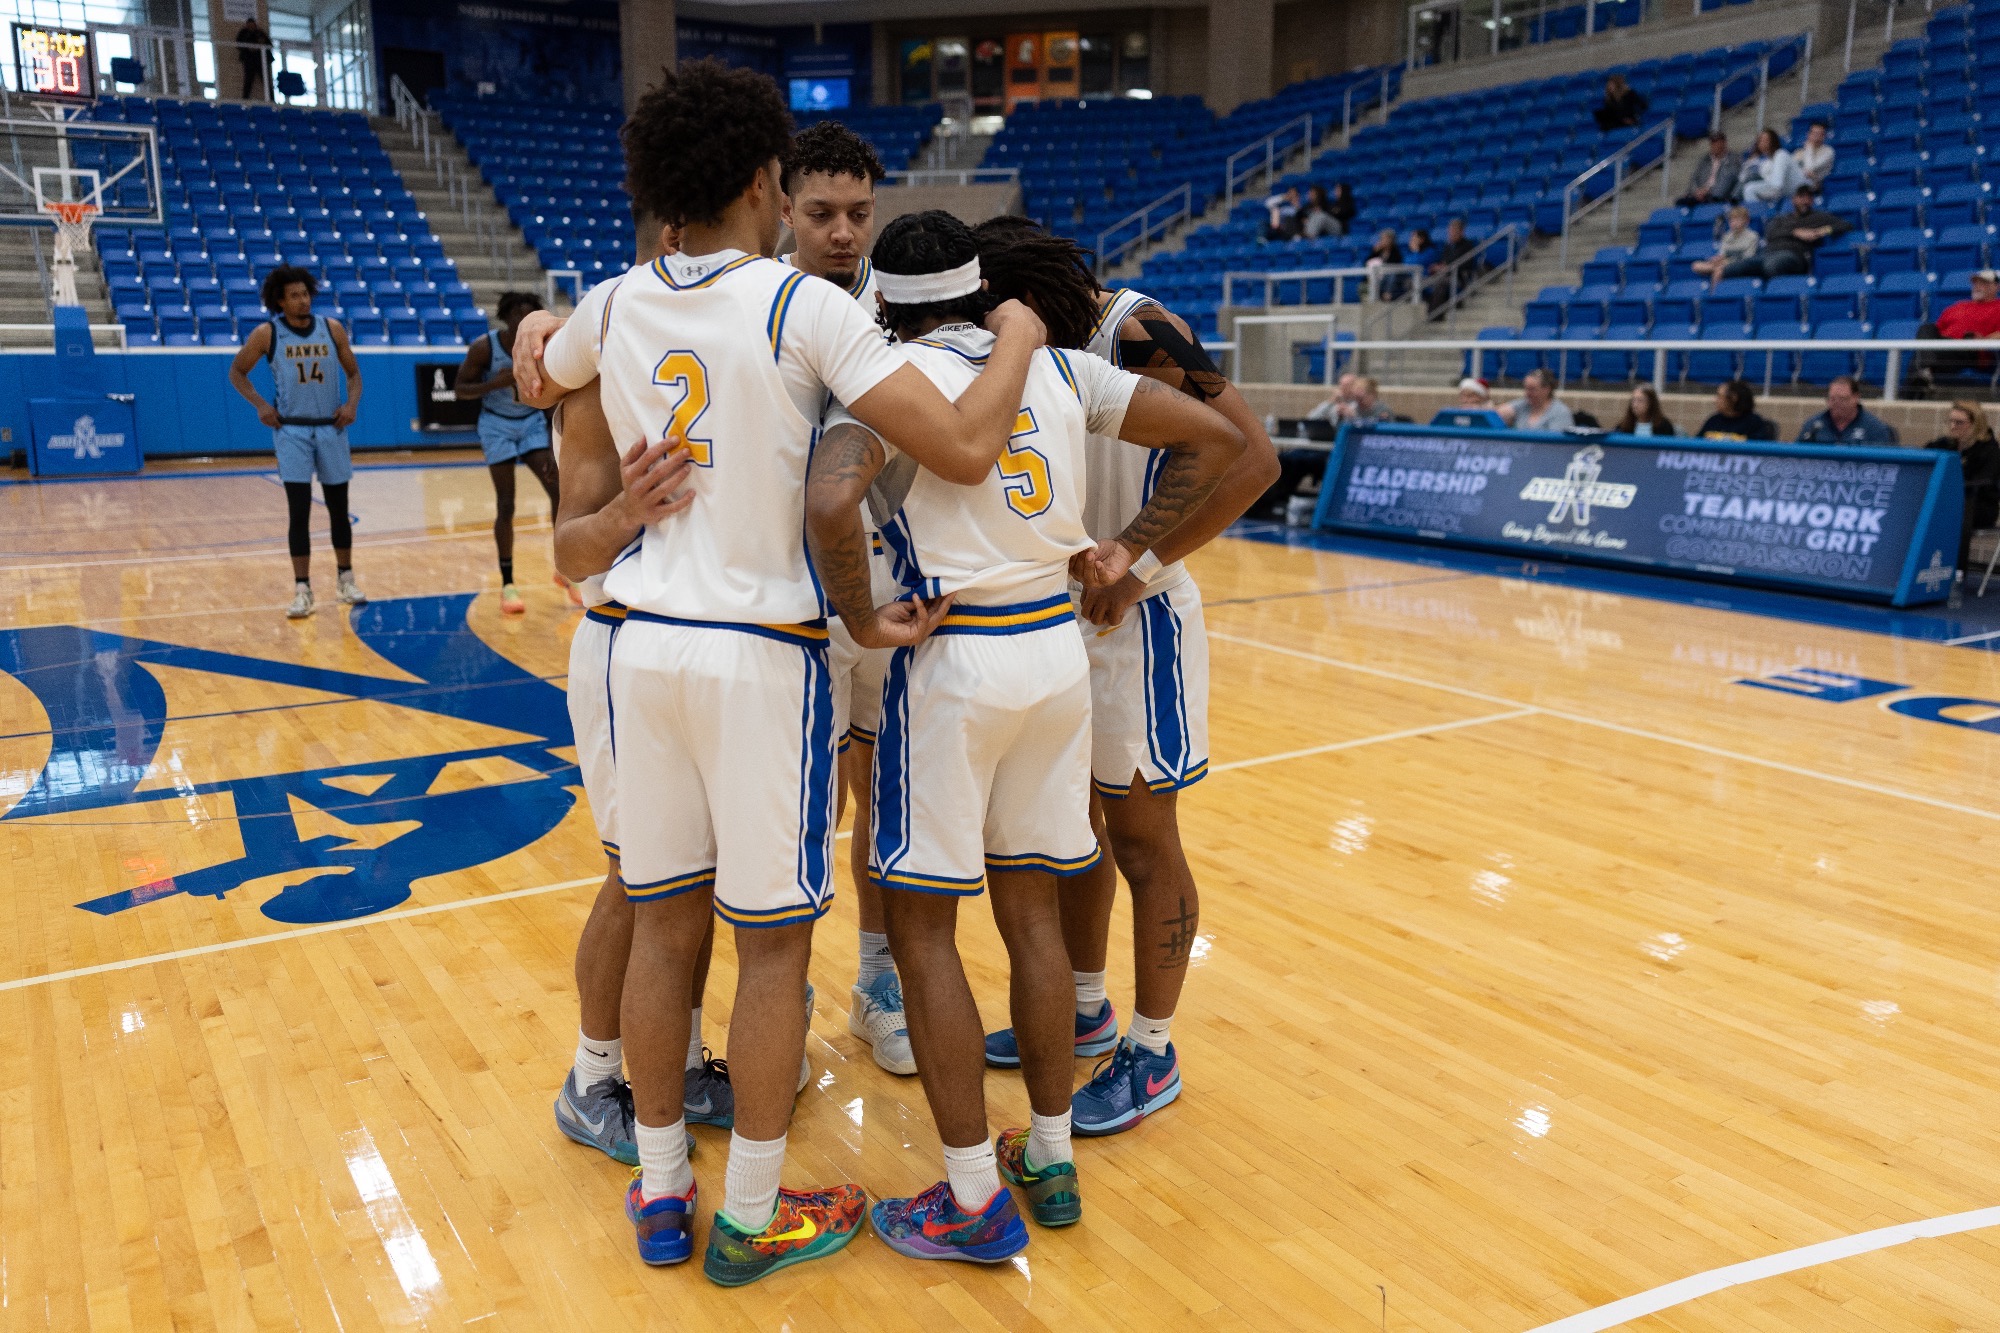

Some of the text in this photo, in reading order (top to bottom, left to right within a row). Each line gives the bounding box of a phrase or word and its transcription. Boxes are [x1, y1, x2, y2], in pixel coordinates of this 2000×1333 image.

[937, 324, 962, 333] NIKE
[285, 343, 329, 359] HAWKS
[295, 361, 325, 384] 14
[652, 350, 713, 468] 2
[996, 406, 1054, 520] 5
[1351, 466, 1488, 495] LEADERSHIP
[1454, 455, 1513, 475] HOPE
[1656, 451, 1899, 486] HUMILITY COURAGE
[1345, 486, 1402, 506] TRUST
[1683, 471, 1896, 507] PERSEVERANCE
[1683, 491, 1888, 534] TEAMWORK
[1658, 513, 1879, 555] COMMITMENT GRIT
[1664, 534, 1873, 581] COMPASSION
